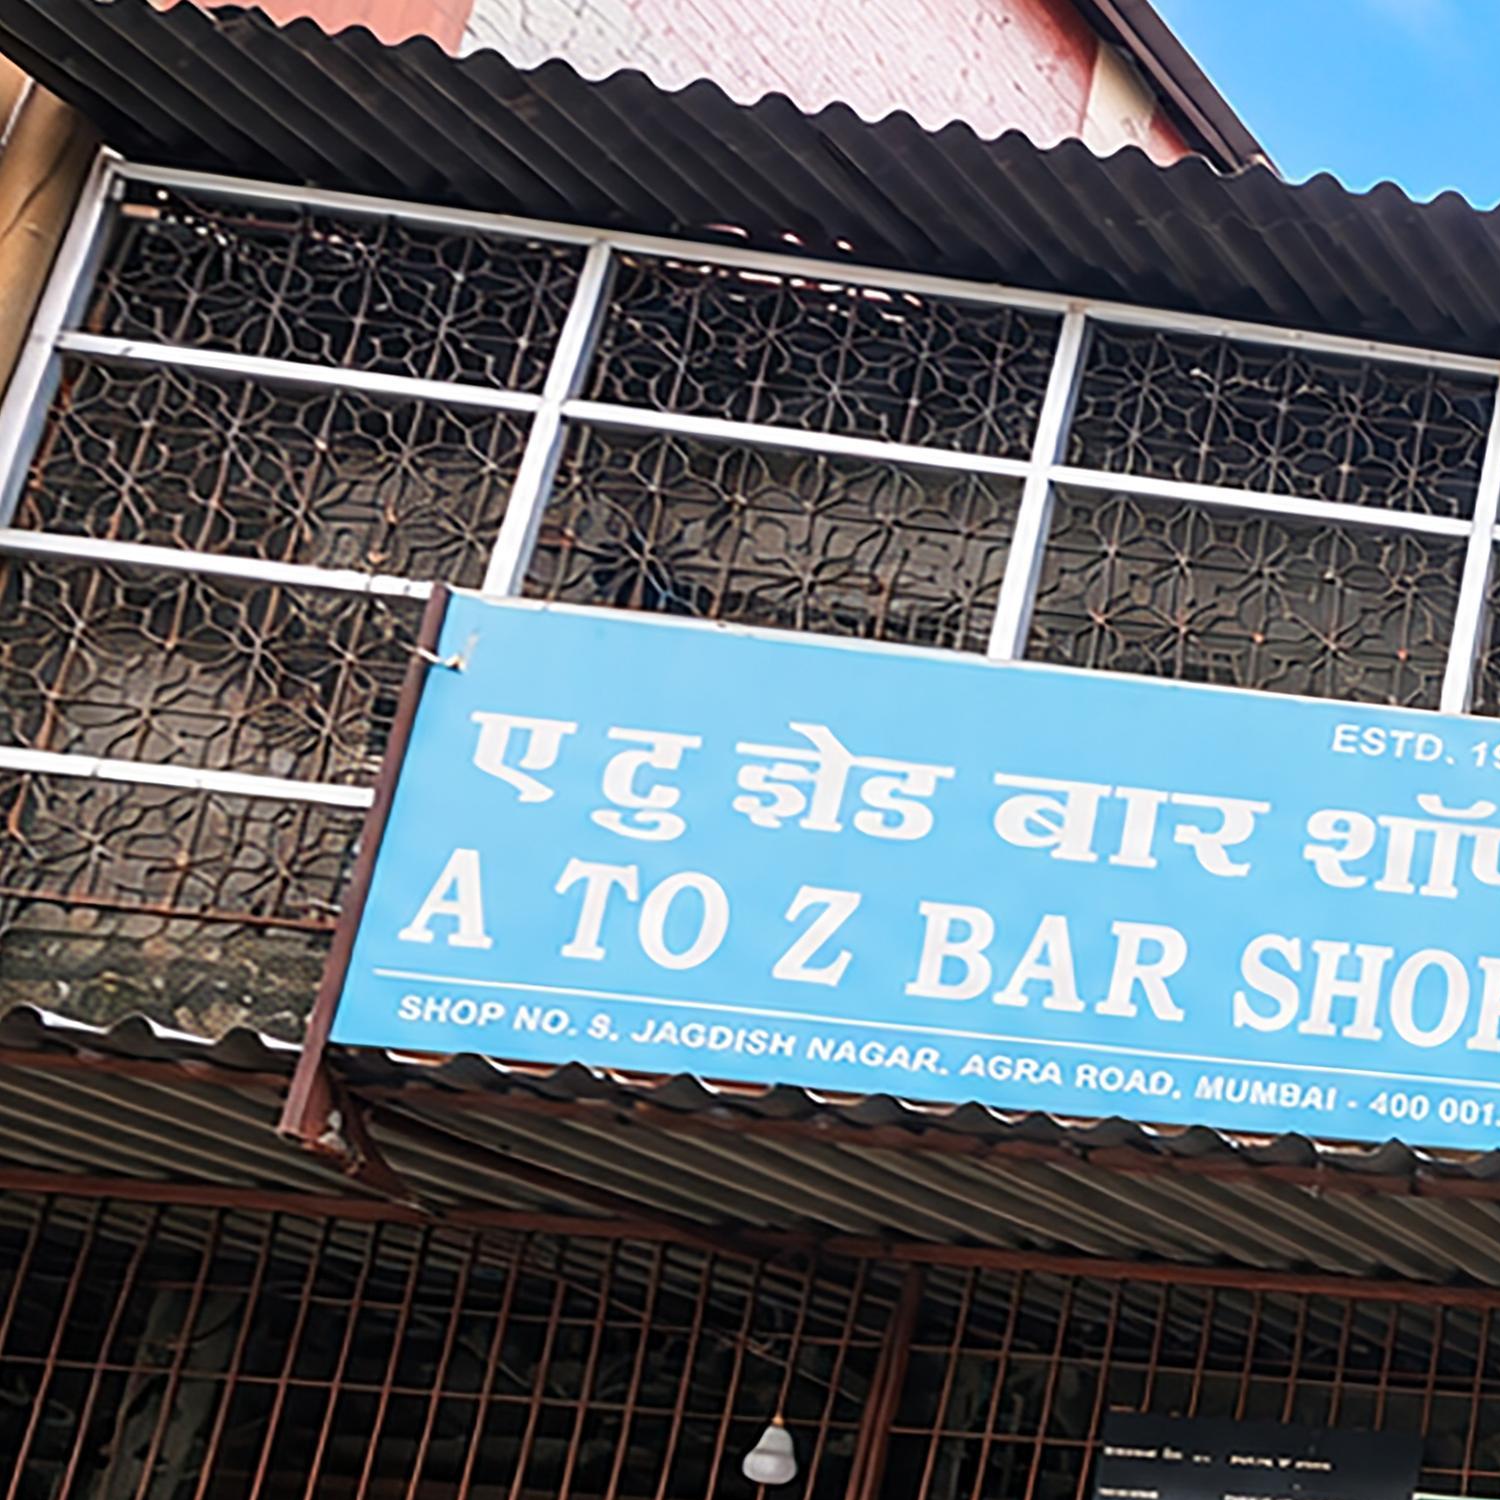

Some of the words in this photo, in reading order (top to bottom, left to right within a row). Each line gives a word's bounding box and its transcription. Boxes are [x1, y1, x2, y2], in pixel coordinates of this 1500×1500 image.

[470, 710, 578, 803] ए
[590, 727, 702, 841] टु
[993, 772, 1271, 877] बार
[1332, 723, 1455, 765] ESTD.
[397, 848, 493, 949] A
[554, 857, 730, 970] TO
[771, 884, 862, 987] Z
[905, 901, 1188, 1022] BAR
[398, 994, 505, 1027] SHOP
[513, 1005, 578, 1036] NO.
[630, 1019, 797, 1057] JAGDISH
[959, 1053, 1063, 1086] AGRA
[1195, 1074, 1337, 1111] MUMBAI
[1369, 1091, 1430, 1121] 400
